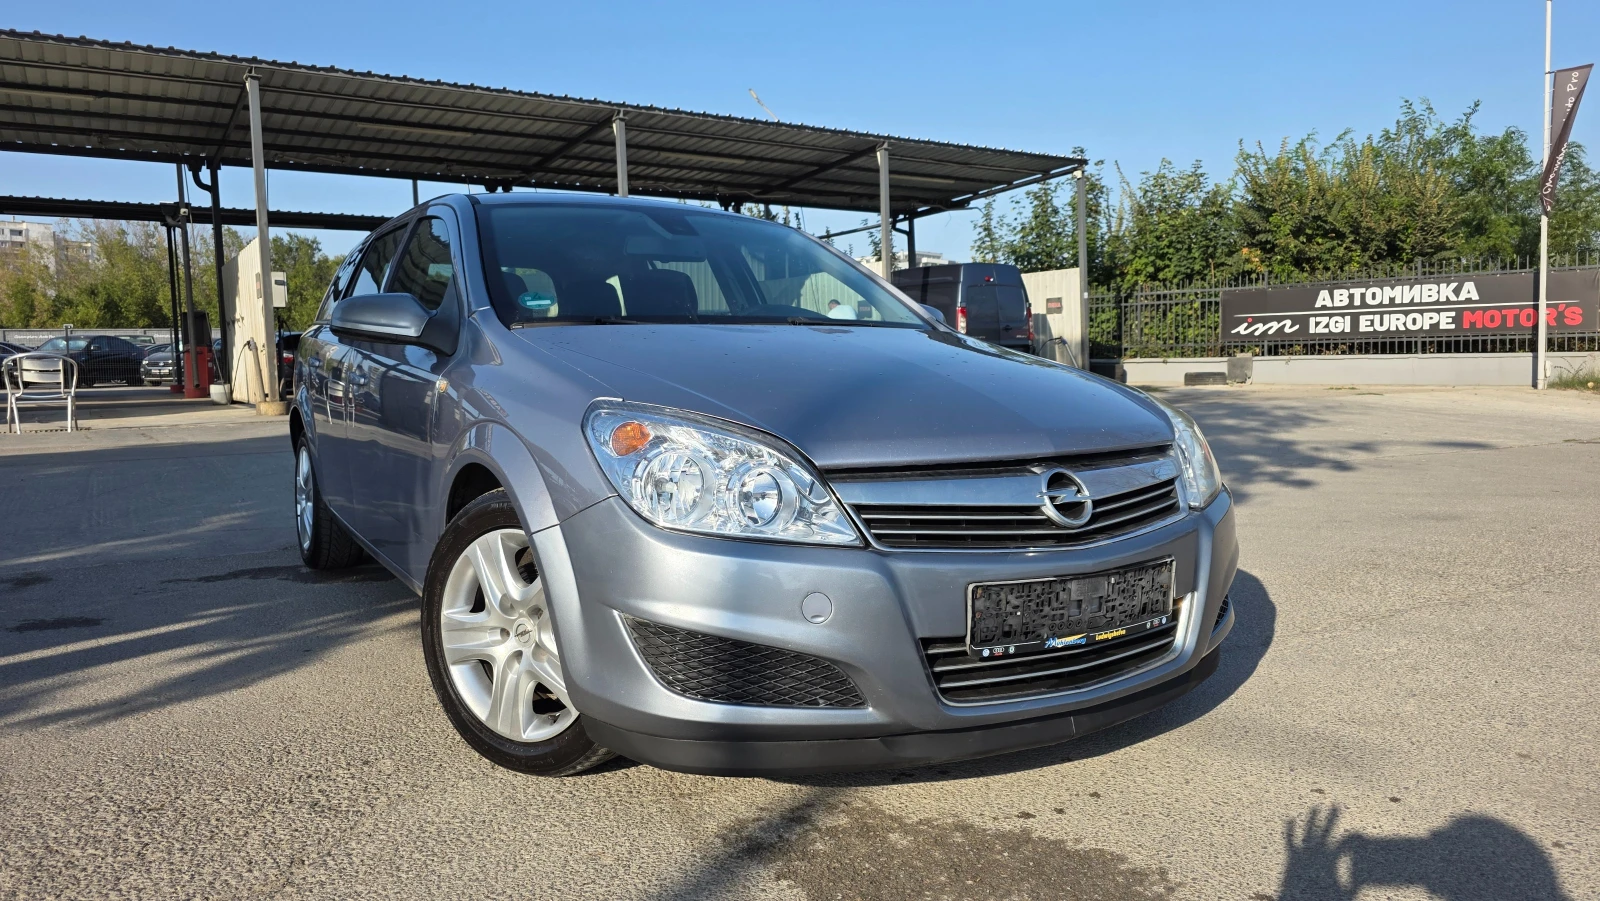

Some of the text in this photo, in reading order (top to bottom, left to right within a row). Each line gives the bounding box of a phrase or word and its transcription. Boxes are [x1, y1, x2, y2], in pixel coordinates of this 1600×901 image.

[1567, 71, 1579, 92] Pro
[1314, 281, 1480, 308] АВТОМИВКА
[1309, 315, 1351, 334] IZGI
[1359, 311, 1456, 332] EUROPE
[1462, 303, 1583, 329] MOTOR'S
